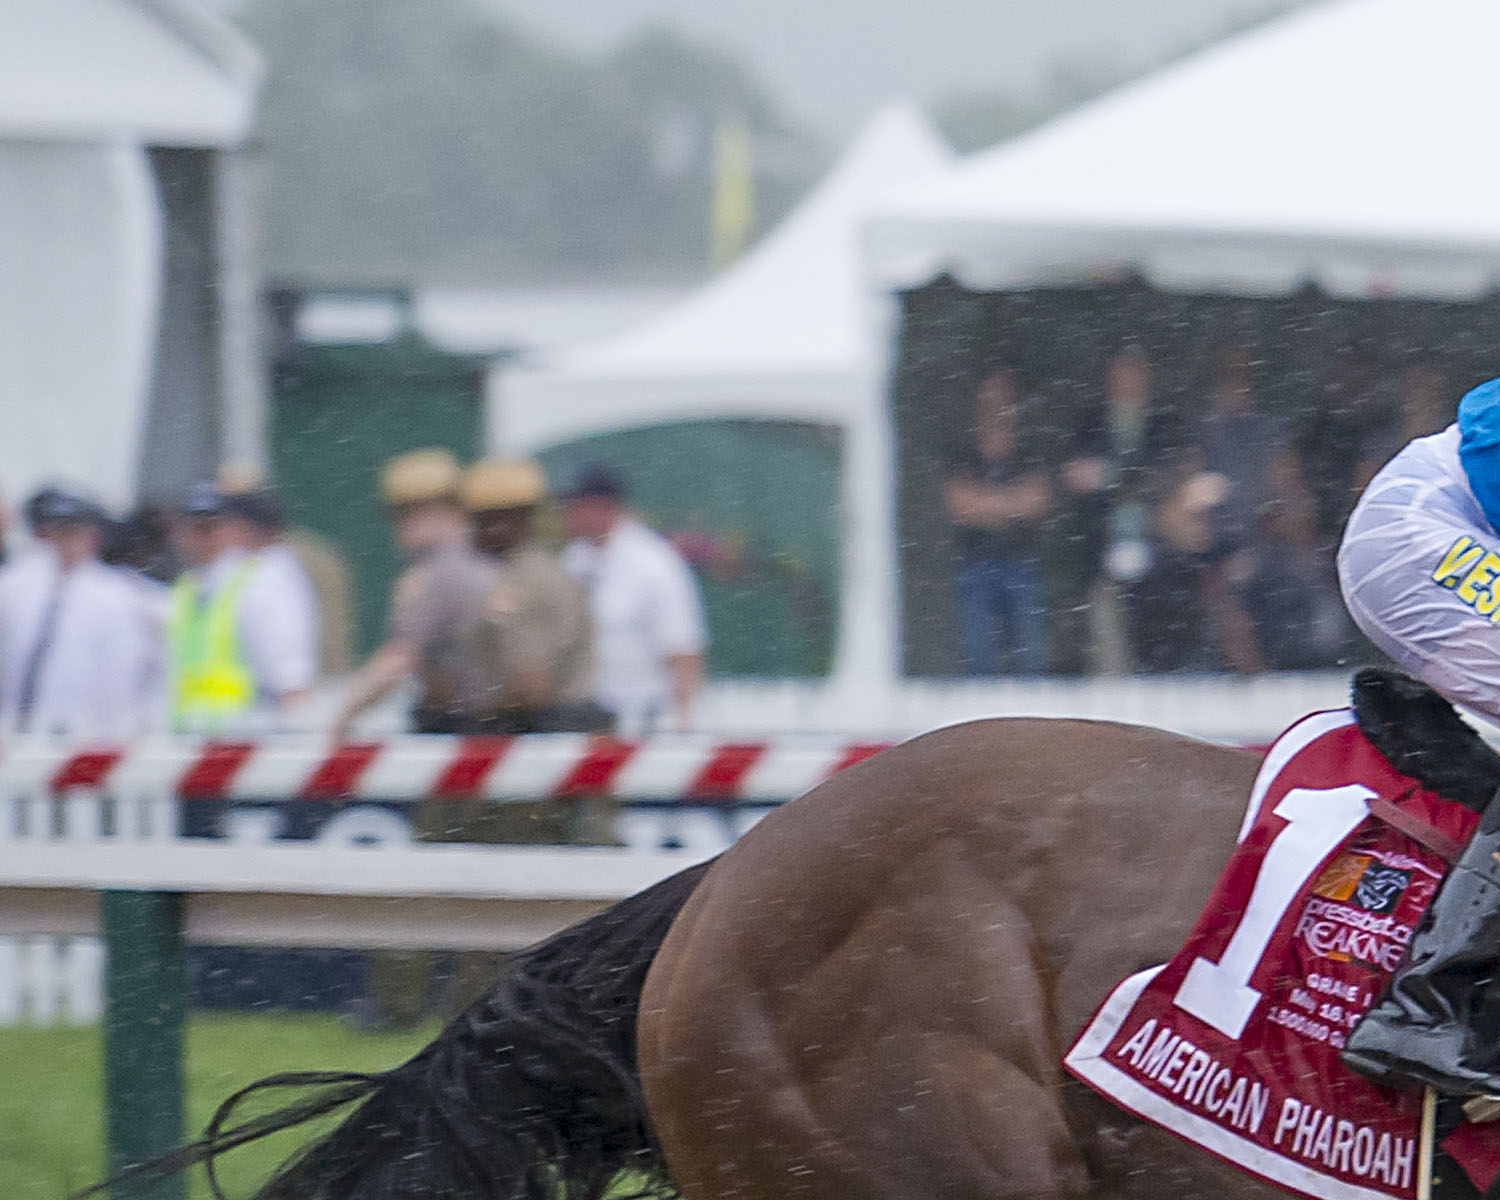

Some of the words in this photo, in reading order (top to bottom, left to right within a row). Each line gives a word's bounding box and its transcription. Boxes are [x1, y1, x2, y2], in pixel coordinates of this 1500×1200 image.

[1172, 783, 1379, 1041] 1
[1118, 1018, 1270, 1135] AMERICAN
[1273, 1097, 1416, 1189] PHAROAH
